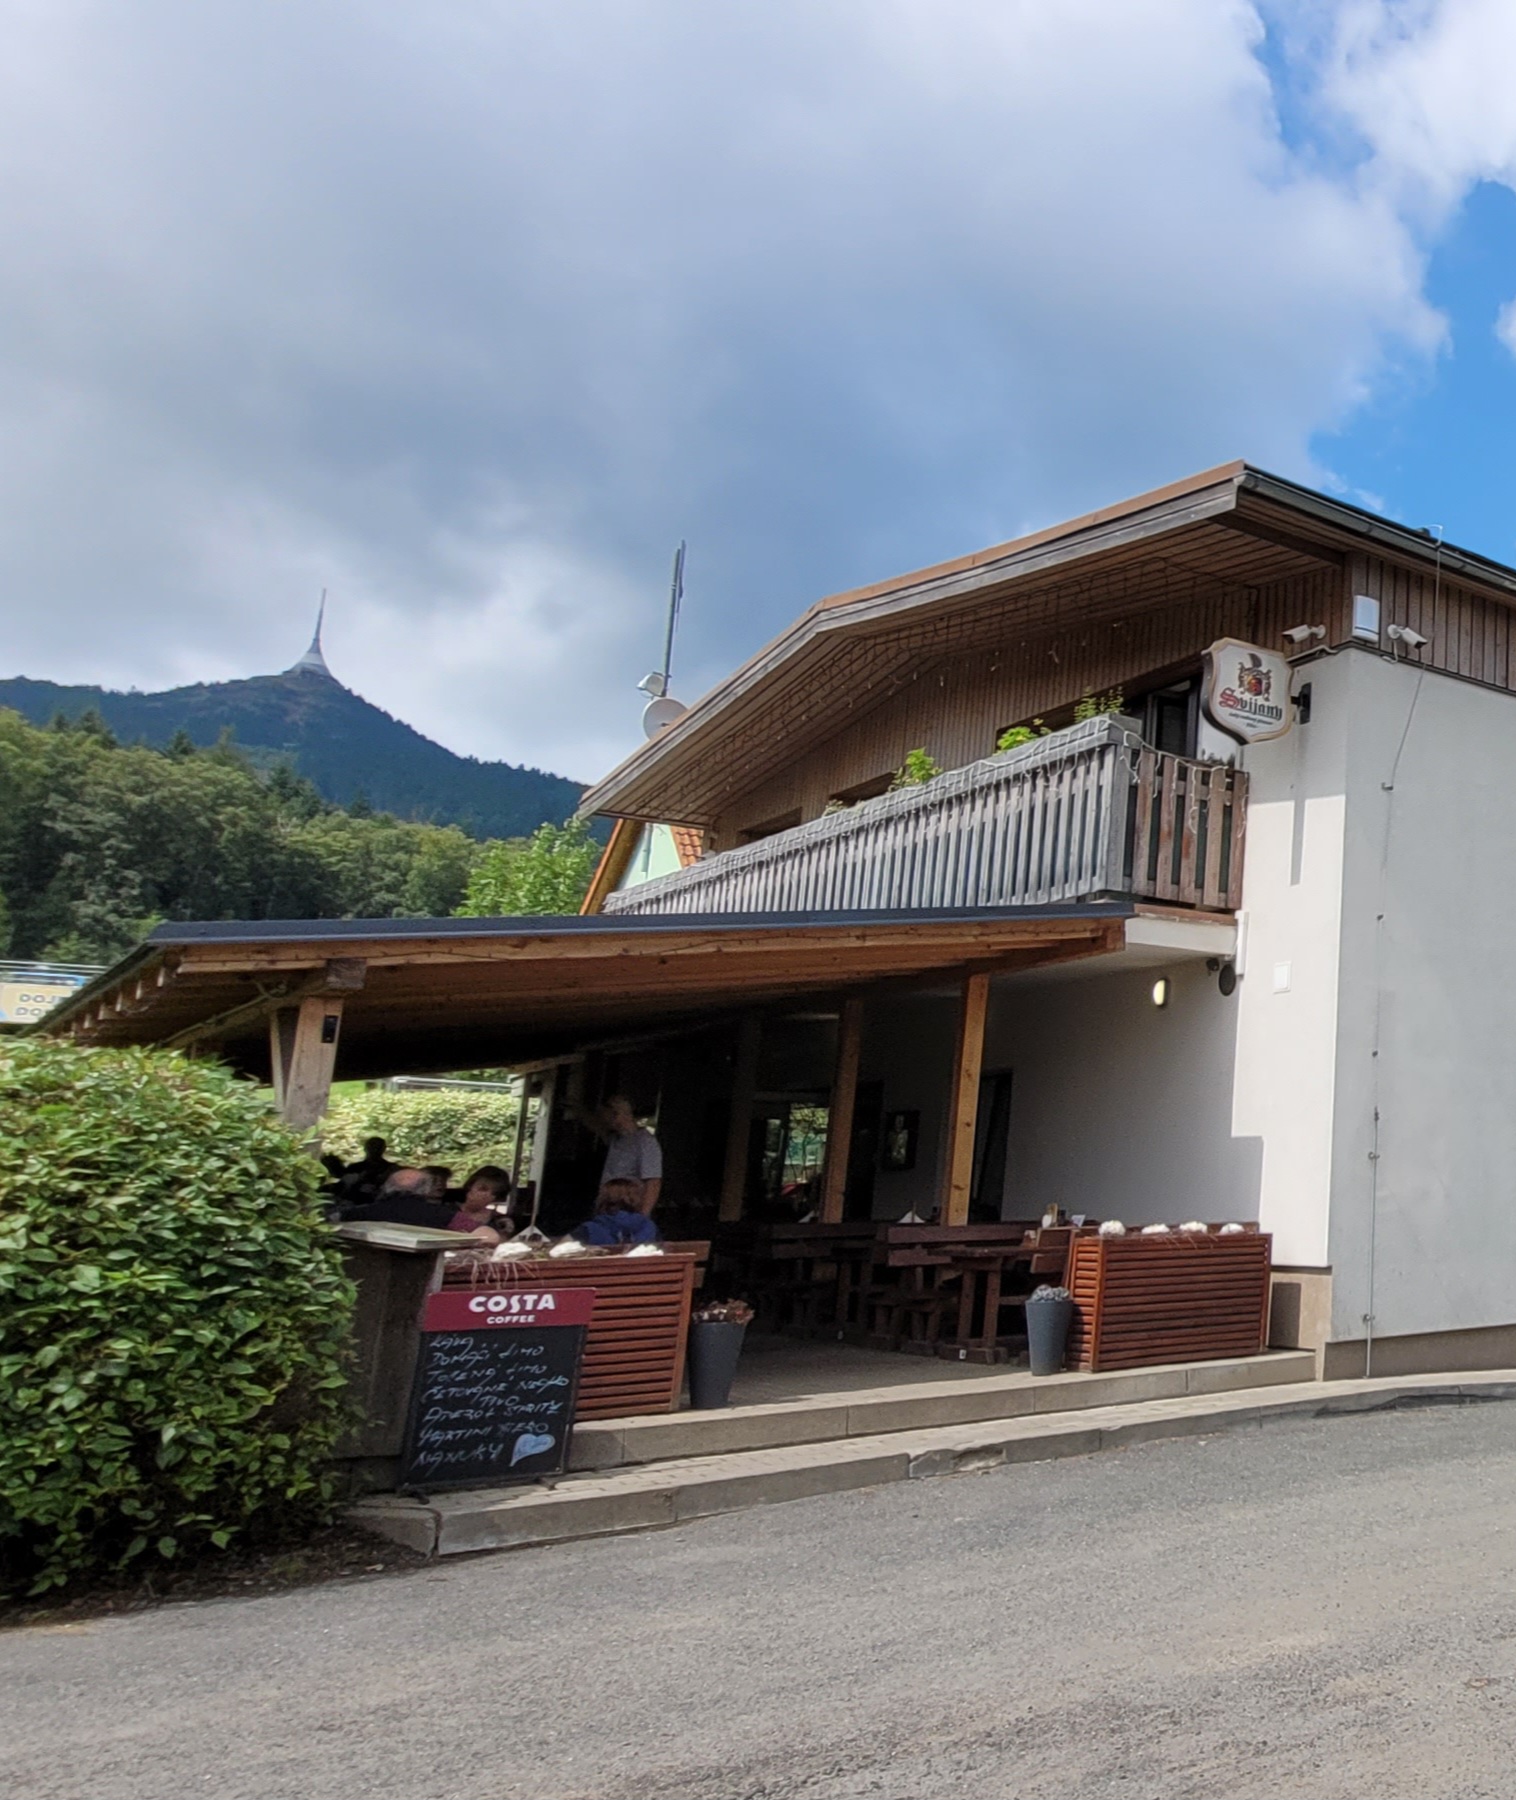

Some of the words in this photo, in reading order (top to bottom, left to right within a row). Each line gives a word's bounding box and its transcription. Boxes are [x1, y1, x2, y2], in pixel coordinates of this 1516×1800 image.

[1219, 687, 1282, 720] Svijany
[469, 1294, 555, 1313] COSTA
[486, 1314, 536, 1325] COFFEE
[499, 1344, 544, 1358] LIMO
[506, 1362, 547, 1375] LIMO
